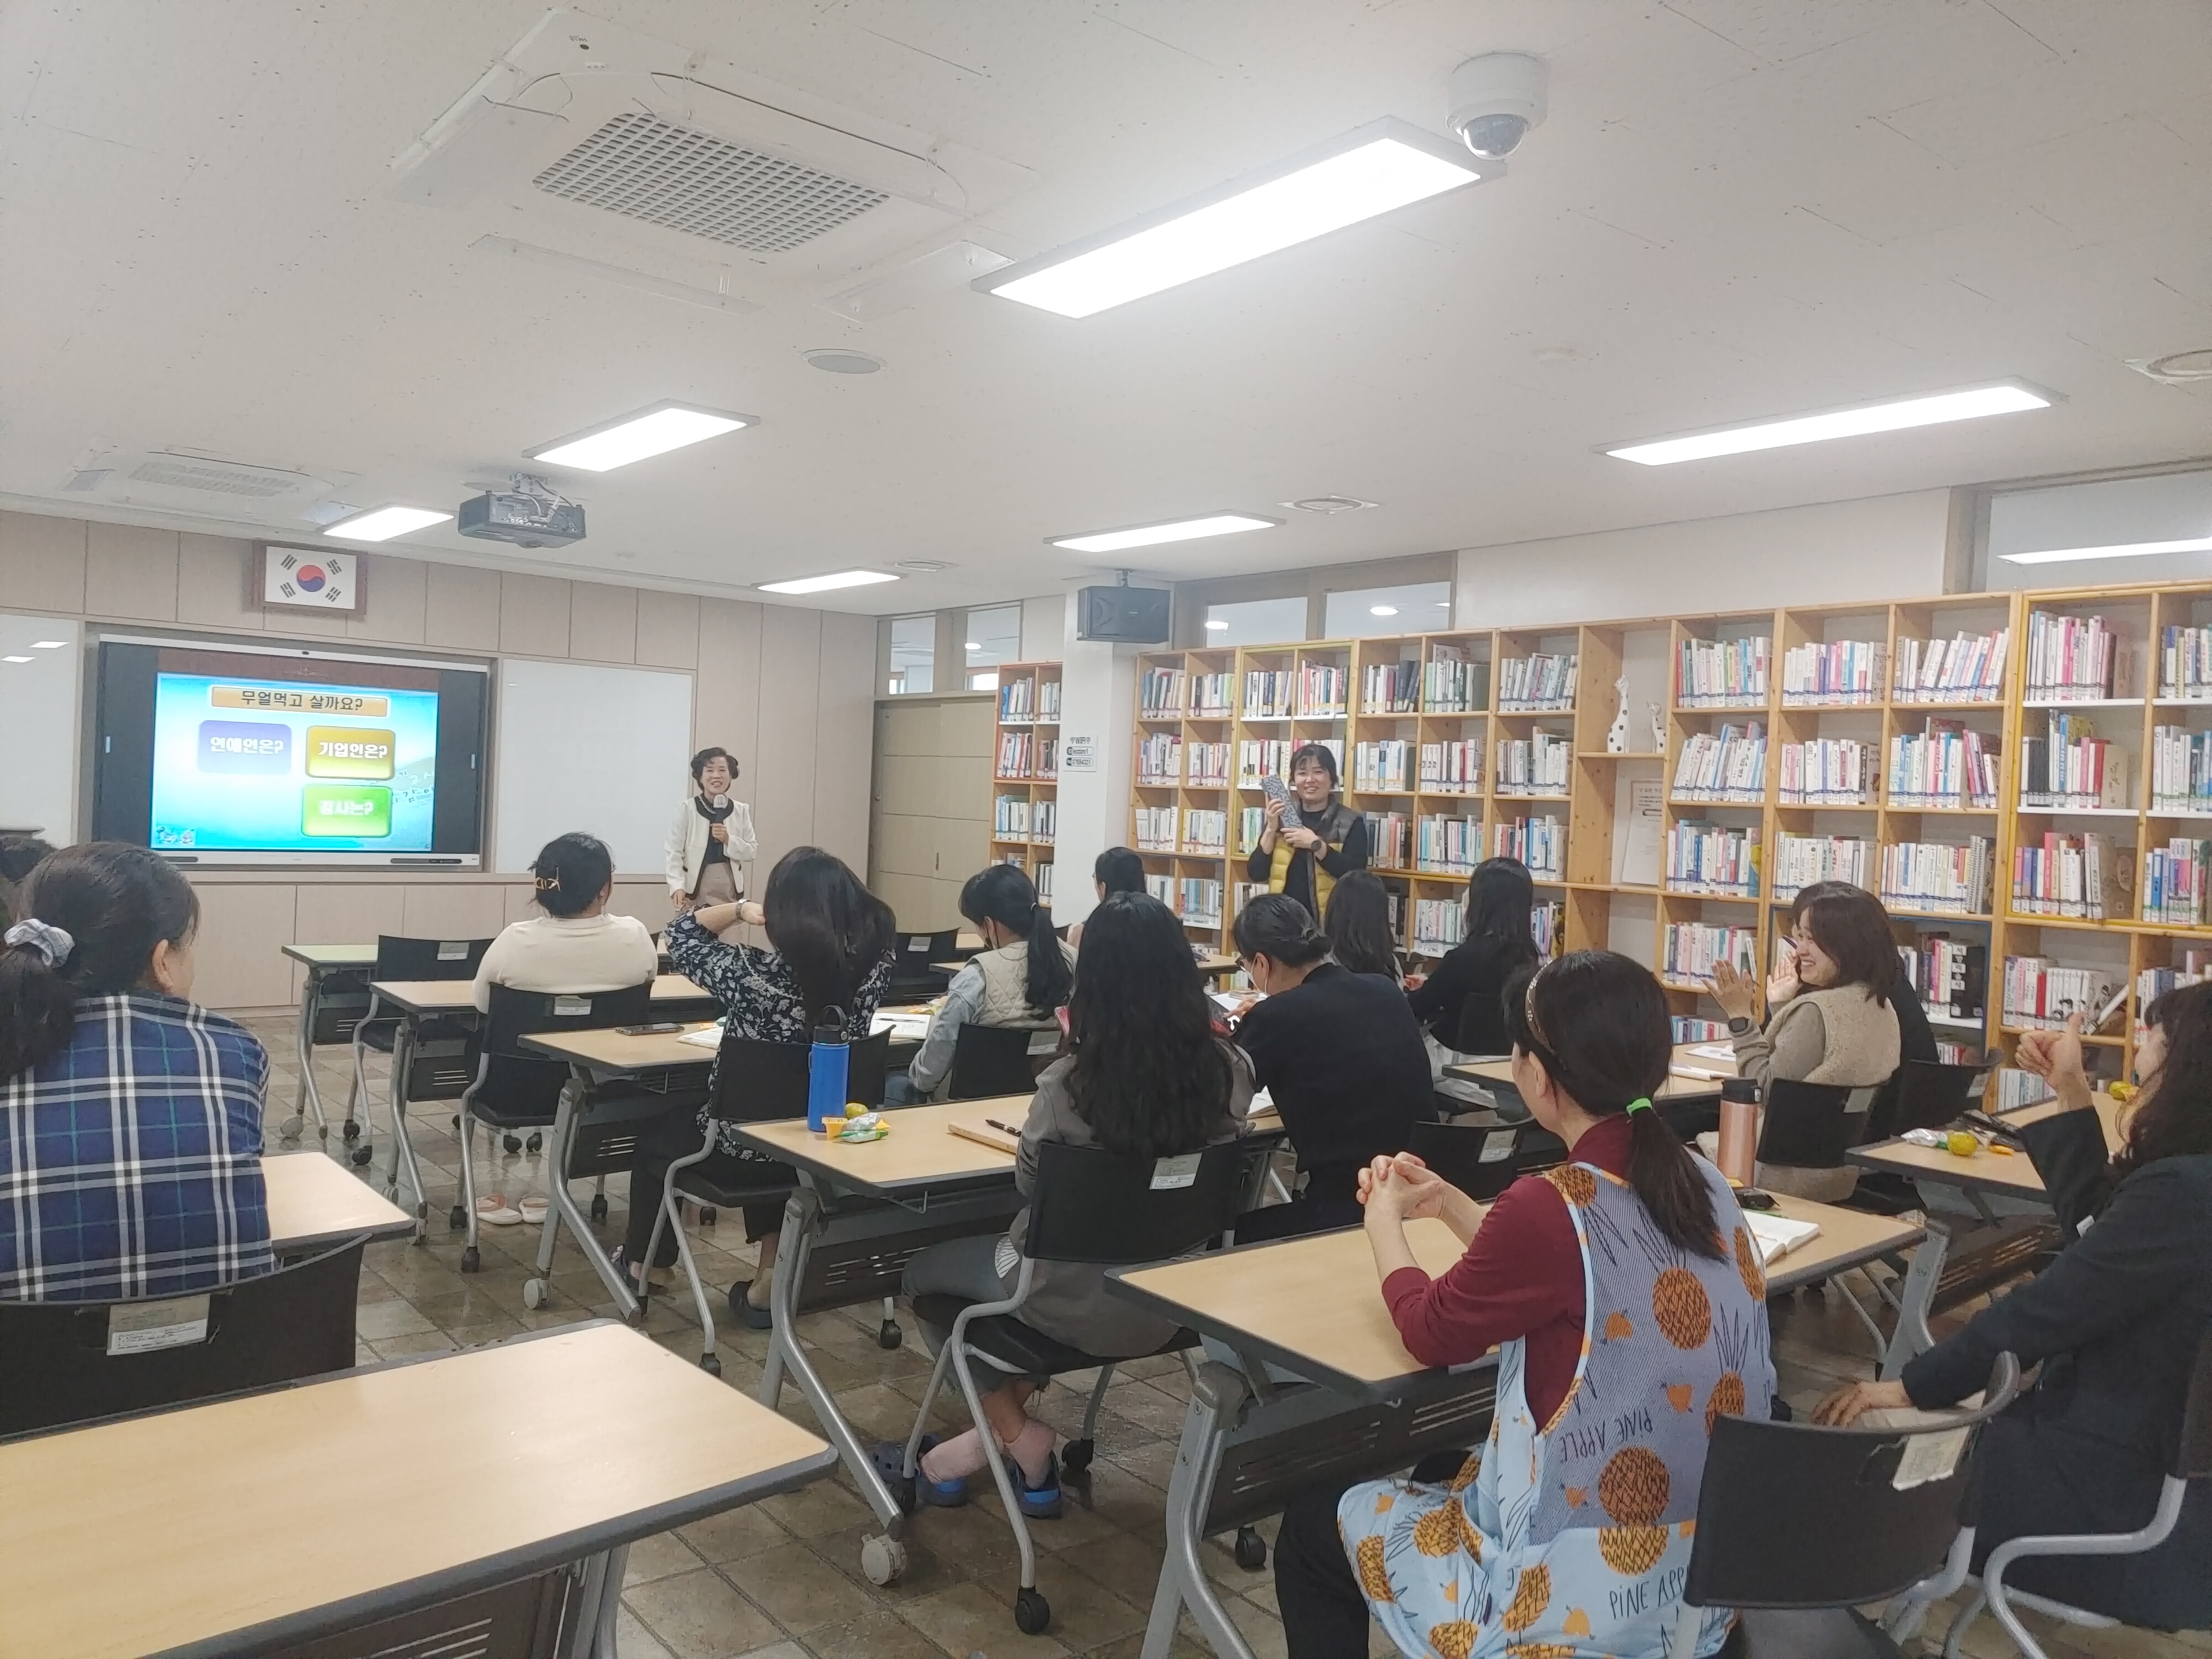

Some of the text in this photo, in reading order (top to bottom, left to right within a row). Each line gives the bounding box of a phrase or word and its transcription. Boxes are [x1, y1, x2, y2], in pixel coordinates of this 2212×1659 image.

[241, 690, 363, 711] 무얼먹고 살까요?
[210, 737, 284, 755] 연예인은?
[318, 742, 388, 759] 기업인은?
[1658, 1564, 1689, 1608] APP
